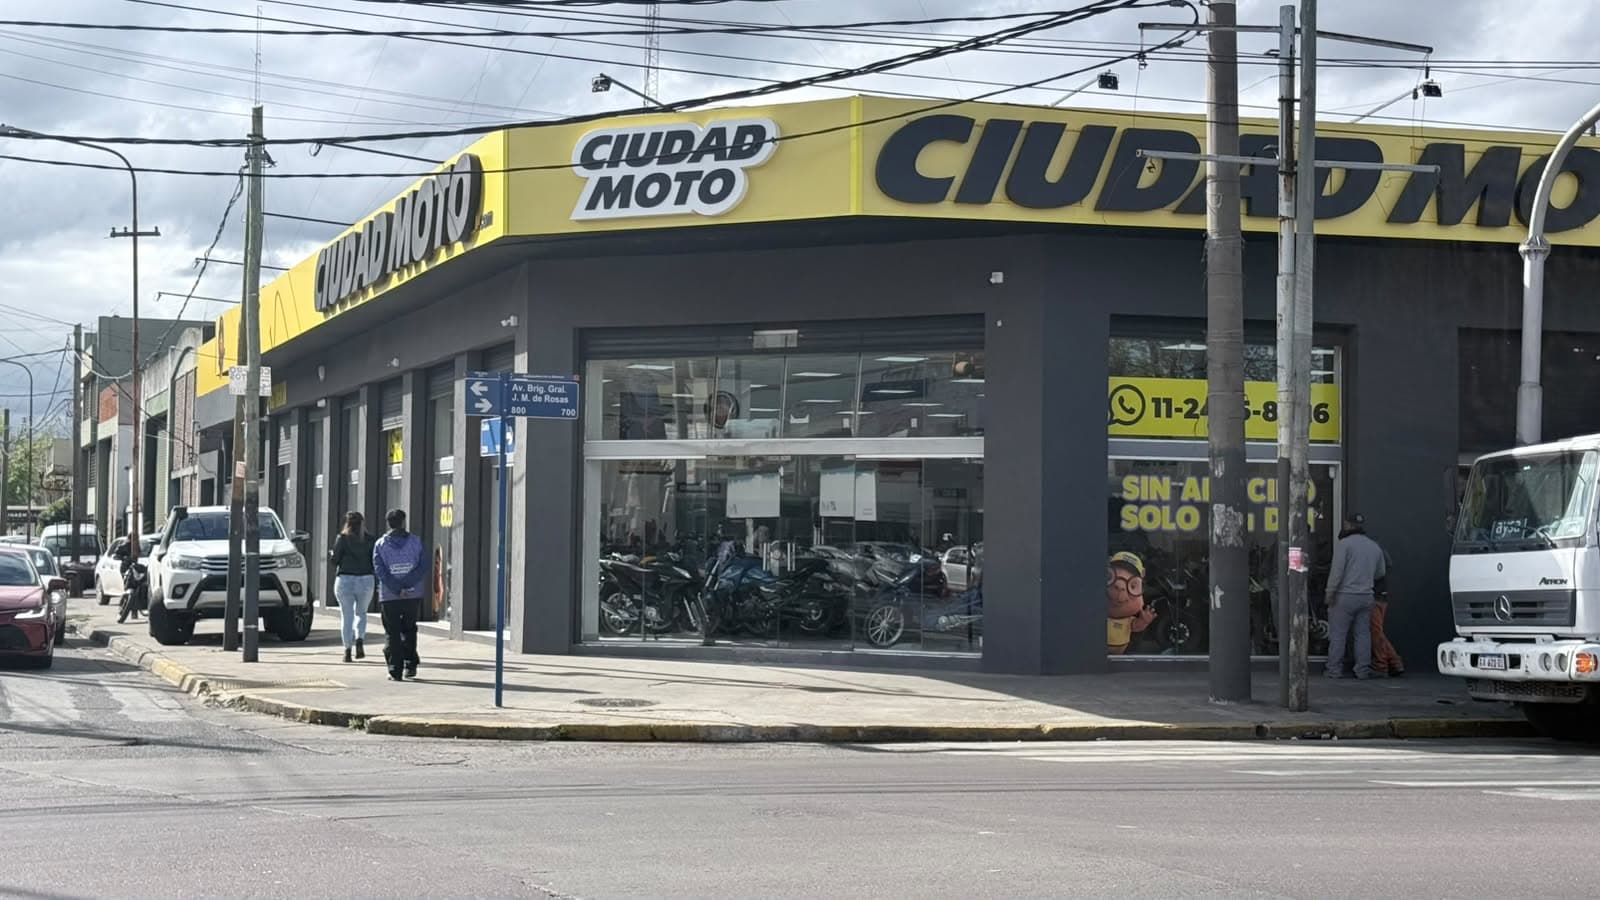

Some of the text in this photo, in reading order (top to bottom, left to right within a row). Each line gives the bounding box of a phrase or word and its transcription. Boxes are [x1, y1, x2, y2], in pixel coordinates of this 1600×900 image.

[580, 124, 767, 170] CIUDAD
[875, 114, 1384, 220] CIUDAD
[584, 168, 736, 211] MOTO
[314, 211, 392, 313] CIUDAD
[387, 152, 482, 274] MOTO
[511, 383, 568, 395] Av. Brig. Gral.
[511, 393, 569, 404] J. M. de Rosas
[511, 406, 577, 417] 800 700
[1122, 475, 1170, 501] SIN
[1121, 503, 1200, 531] SOLO
